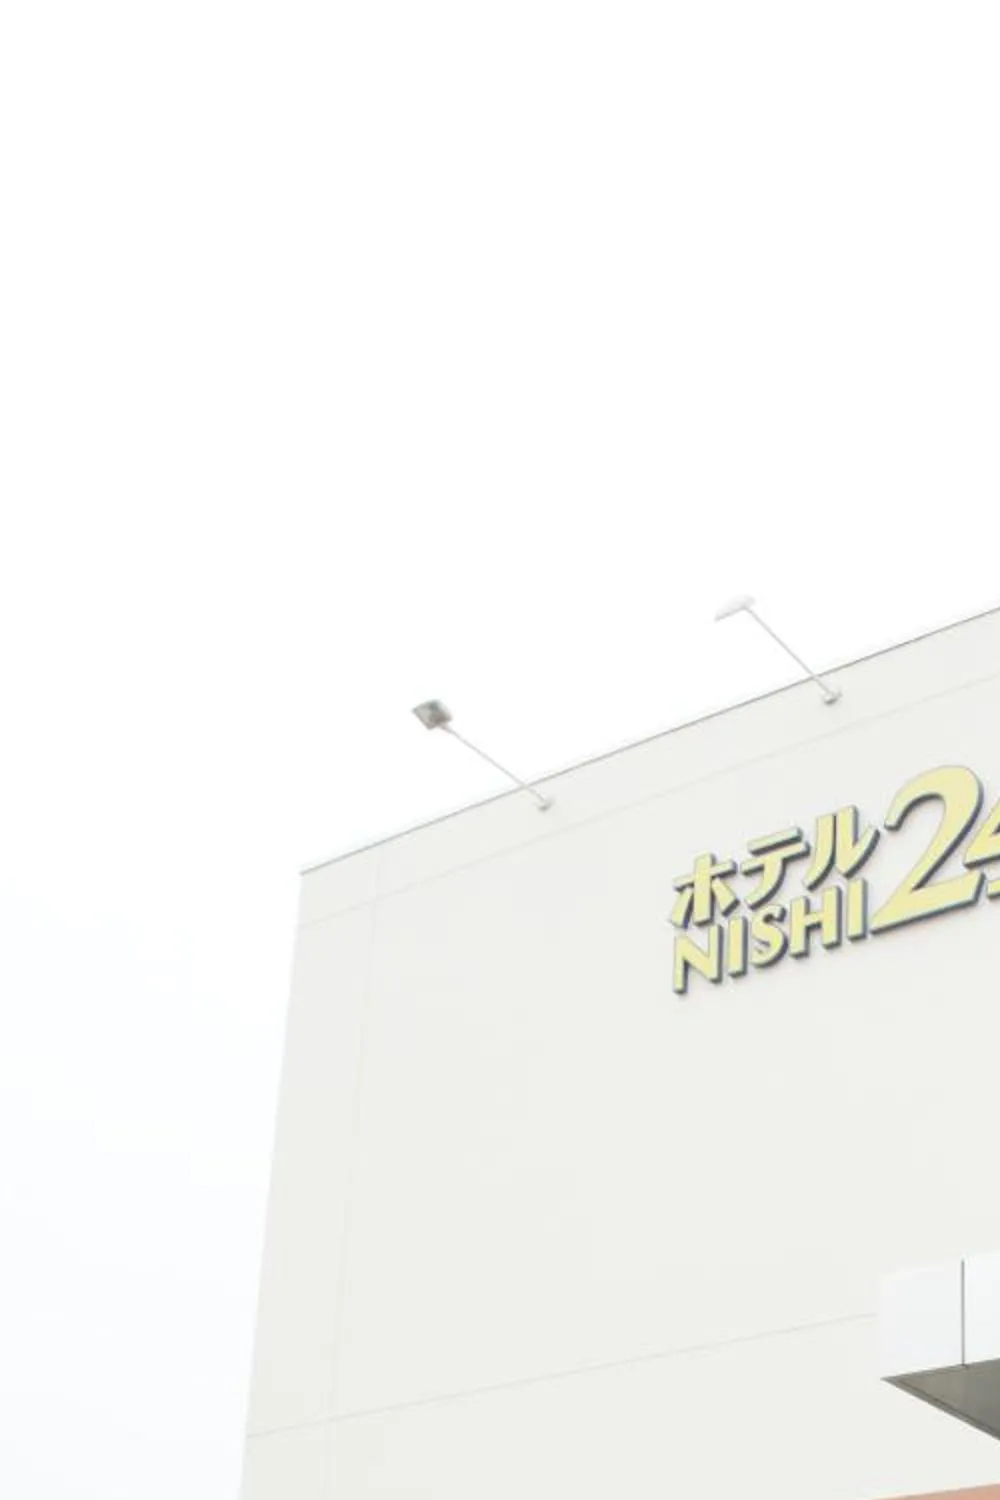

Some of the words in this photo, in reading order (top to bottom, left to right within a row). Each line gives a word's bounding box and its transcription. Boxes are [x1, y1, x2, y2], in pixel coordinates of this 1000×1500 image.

[671, 805, 880, 928] ホテル
[673, 878, 868, 995] NISHI
